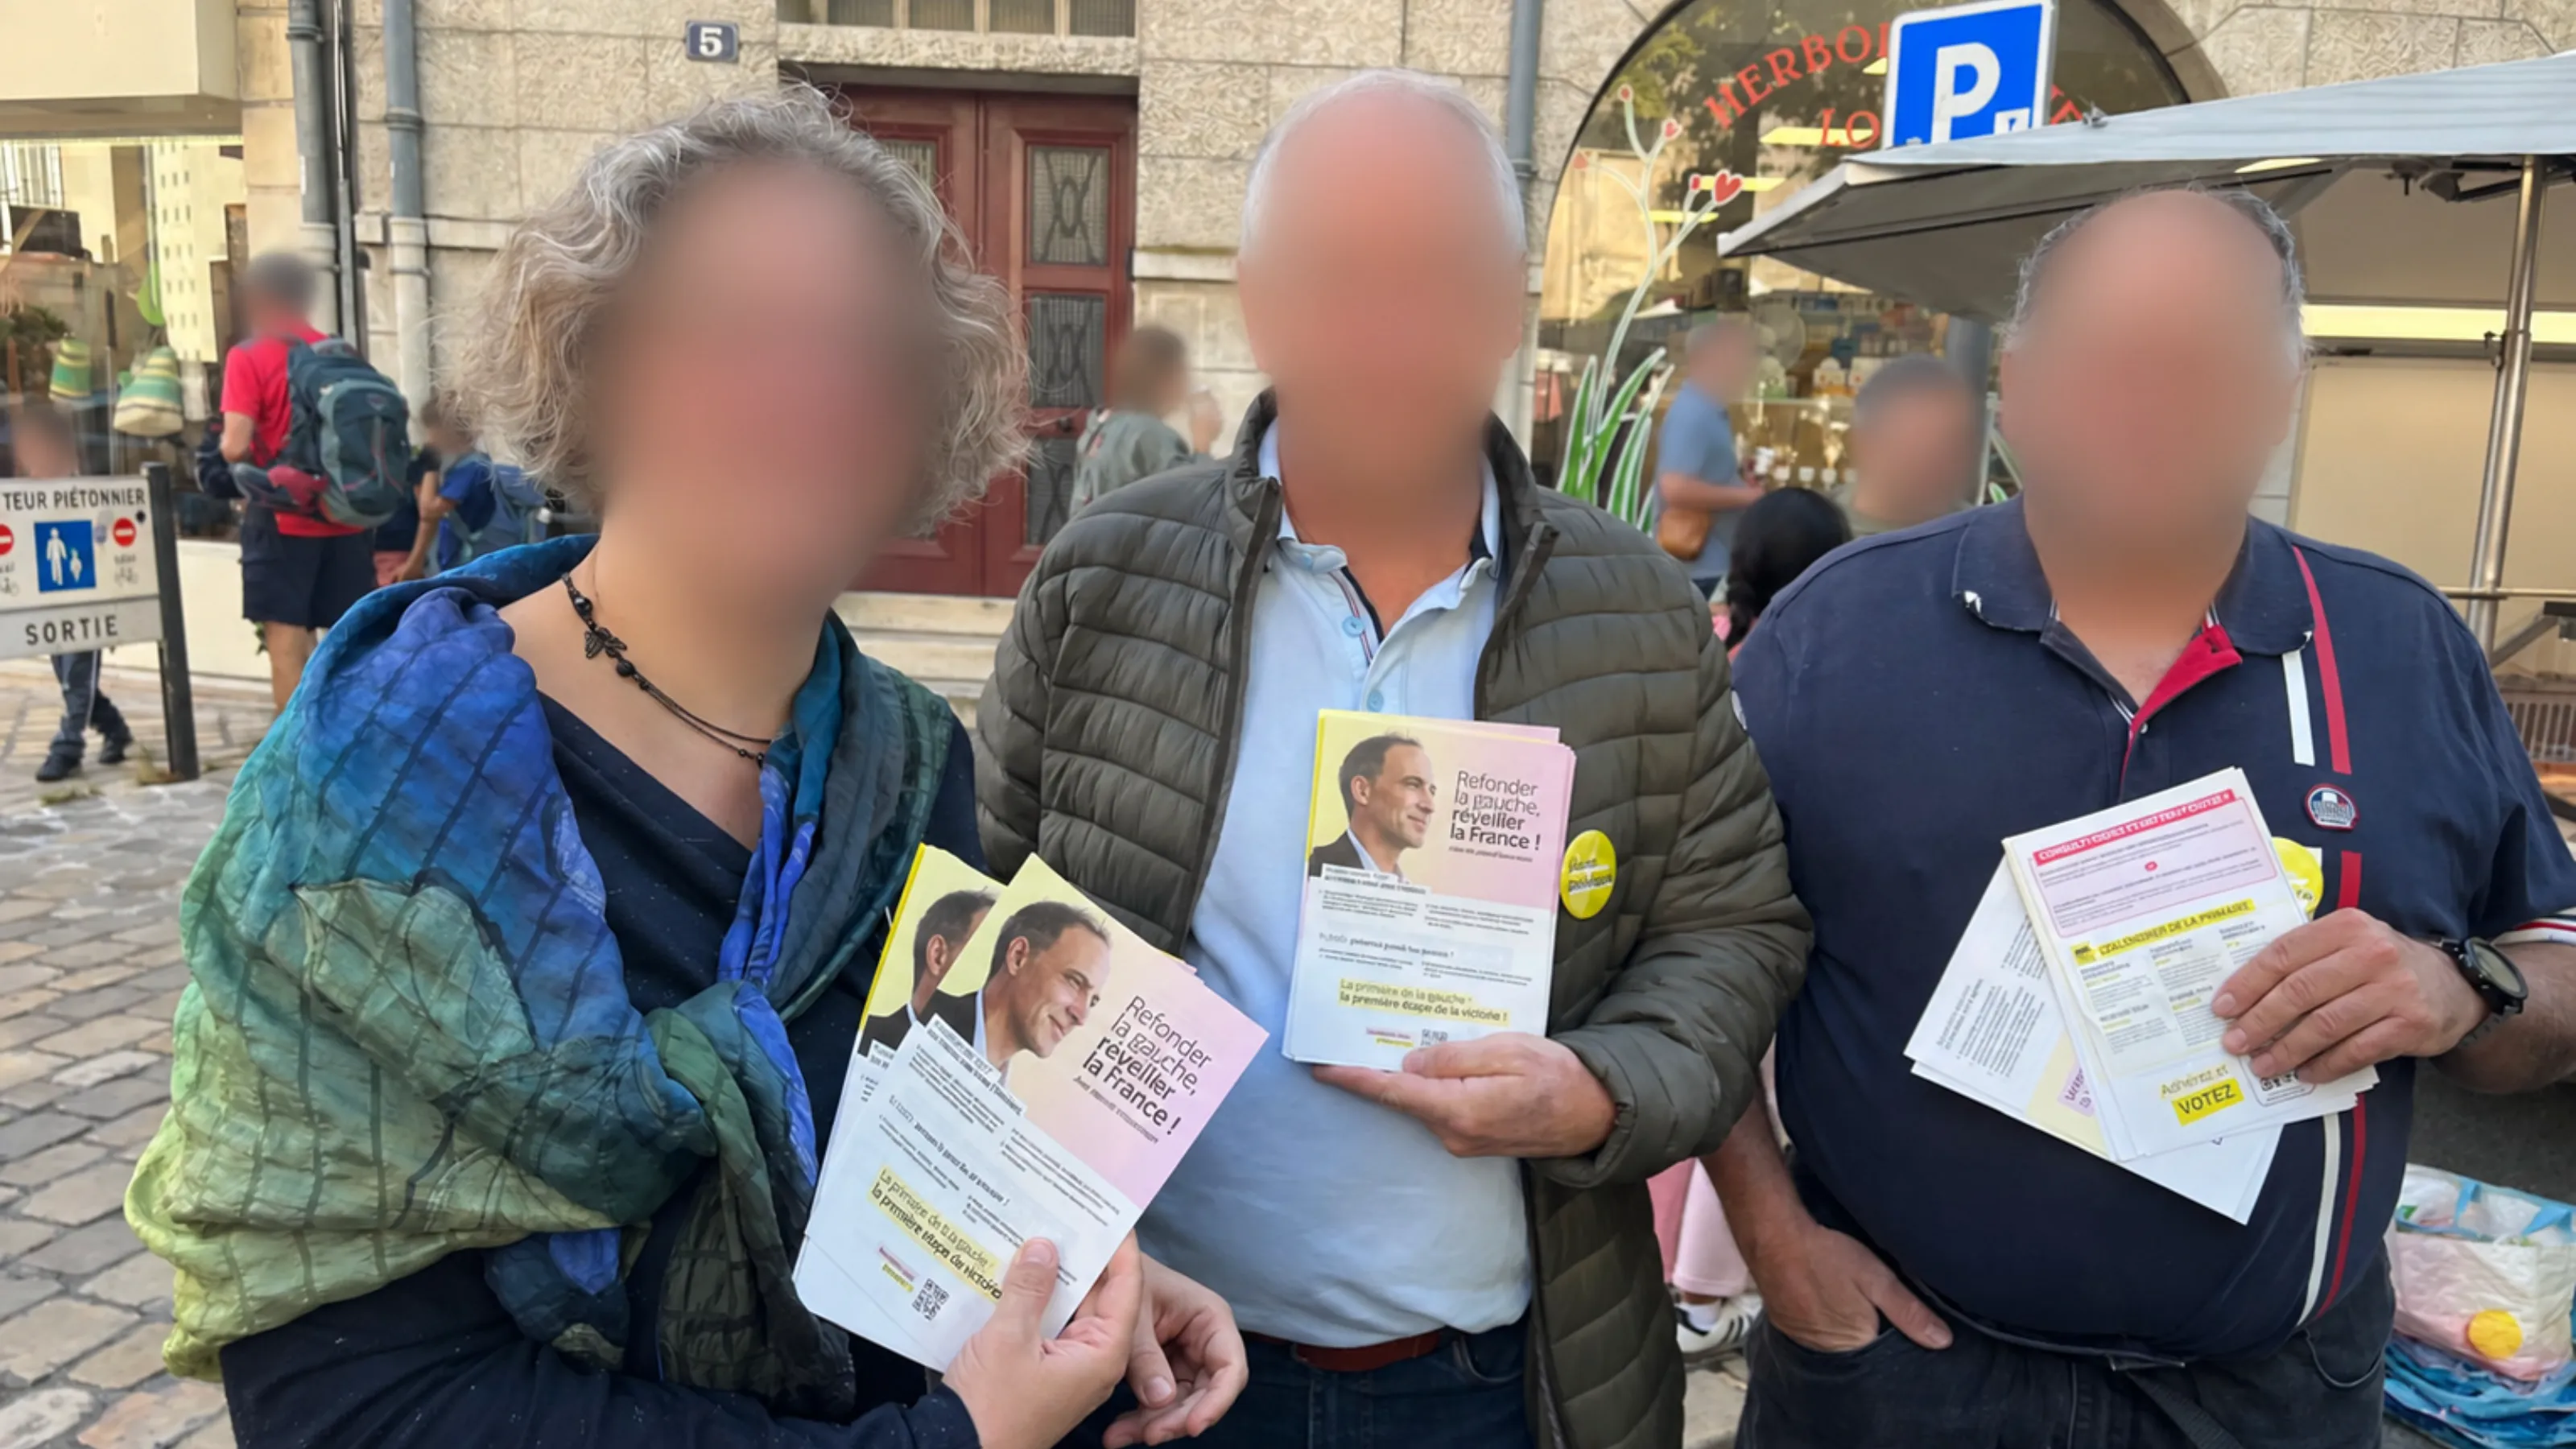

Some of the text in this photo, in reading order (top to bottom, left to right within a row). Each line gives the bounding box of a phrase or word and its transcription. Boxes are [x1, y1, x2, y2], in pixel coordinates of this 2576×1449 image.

[699, 27, 722, 57] 5
[1931, 42, 2001, 143] P
[1821, 107, 1881, 150] LO
[2, 486, 146, 512] TEUR PIÉTONNIER
[26, 615, 118, 645] SORTIE
[1458, 770, 1538, 797] Refonder
[1451, 807, 1525, 831] réveiller
[1450, 822, 1465, 840] la
[1469, 826, 1530, 849] France
[1110, 1012, 1131, 1038] la
[1125, 995, 1212, 1069] Refonder
[1083, 1050, 1104, 1077] la
[1103, 1065, 1168, 1127] France
[2178, 1084, 2236, 1115] VOTEZ
